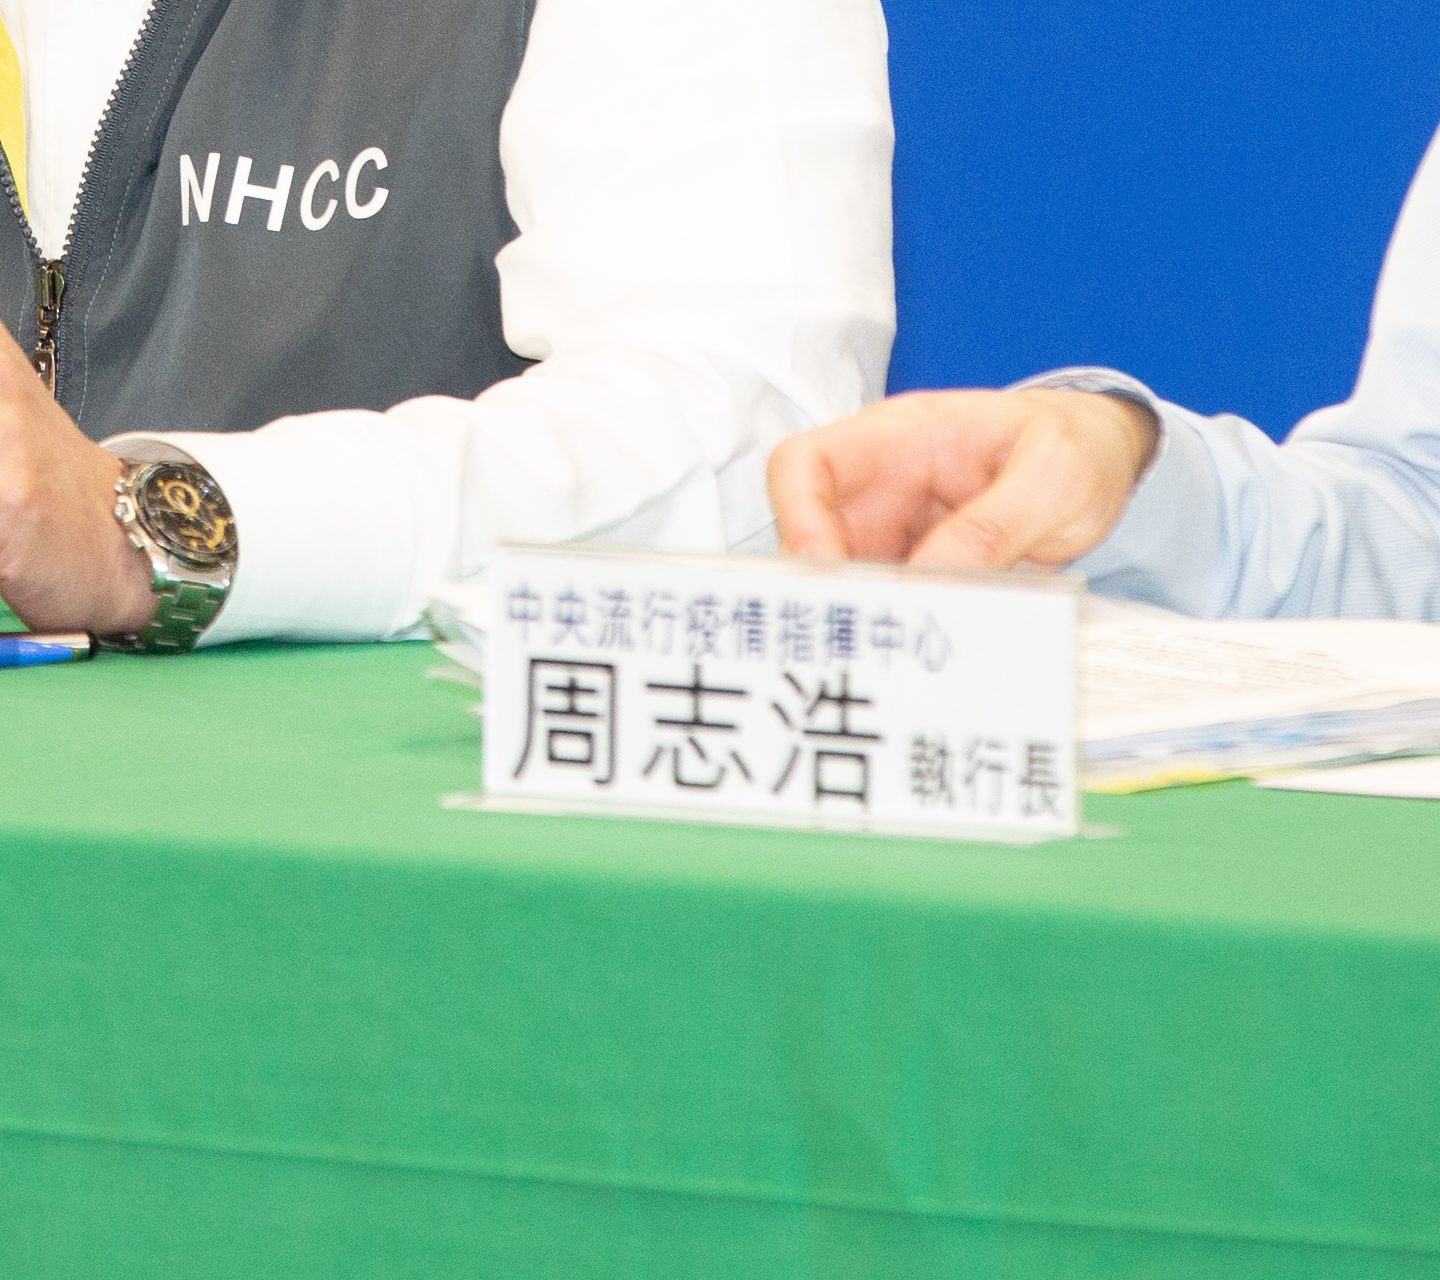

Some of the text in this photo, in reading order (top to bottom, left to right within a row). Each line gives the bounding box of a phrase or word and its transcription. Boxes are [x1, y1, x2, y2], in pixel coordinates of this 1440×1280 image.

[179, 146, 389, 232] NHCC
[506, 584, 954, 673] 中央流行疫情指揮中心
[512, 655, 1067, 821] 周志浩 執行長
